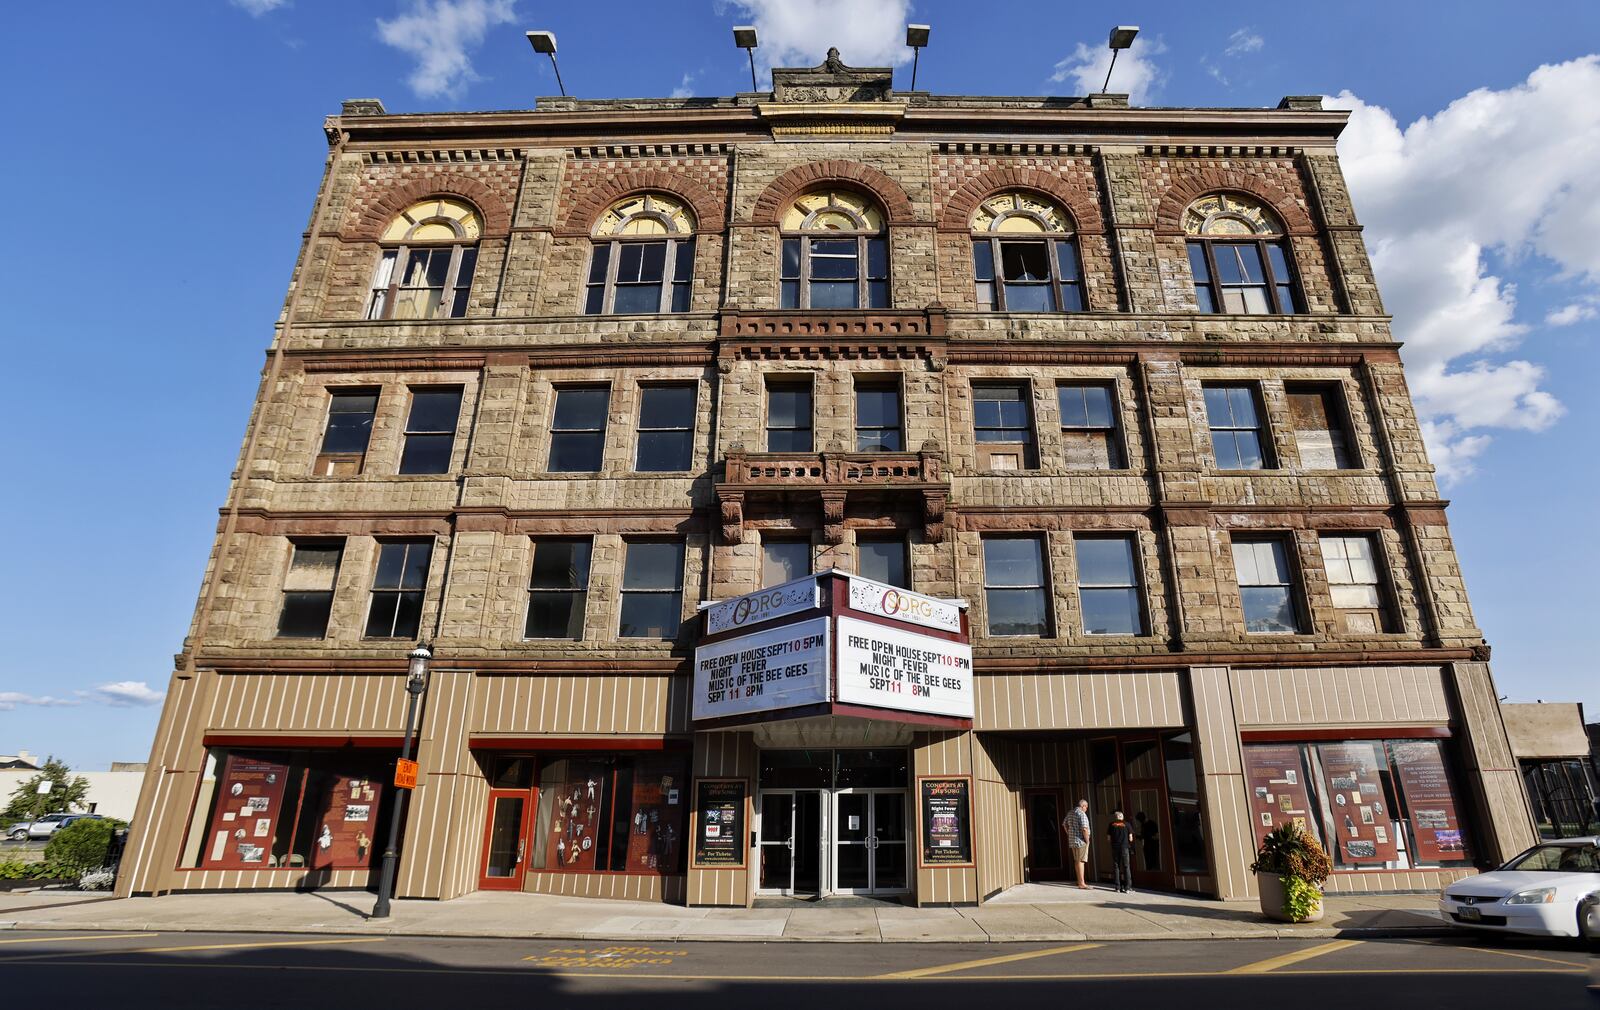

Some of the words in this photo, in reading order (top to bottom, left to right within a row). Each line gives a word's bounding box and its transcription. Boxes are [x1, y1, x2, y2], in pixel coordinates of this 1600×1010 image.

[700, 657, 718, 671] FREE
[718, 653, 739, 667] OPEN
[741, 647, 766, 663] HOUSE
[803, 634, 824, 650] 5PM
[848, 634, 869, 650] FREE
[871, 639, 894, 655] OPEN
[895, 645, 922, 661] HOUSE
[954, 656, 970, 670] 5PM
[872, 652, 896, 668] NIGHT
[902, 658, 928, 674] FEVER
[708, 677, 734, 692] MUSIC
[736, 674, 747, 687] OF
[749, 671, 764, 684] THE
[765, 667, 783, 682] BEE
[785, 663, 808, 678] GEES
[710, 665, 733, 681] NIGHT
[741, 659, 767, 674] FEVER
[860, 662, 891, 679] MUSIC
[893, 668, 904, 681] OF
[906, 671, 921, 684] THE
[924, 674, 940, 687] BEE
[942, 677, 962, 690] GEES
[708, 690, 726, 704] SEPT
[729, 687, 739, 700] 11
[745, 683, 763, 697] 8PM
[912, 684, 930, 698] 8PM
